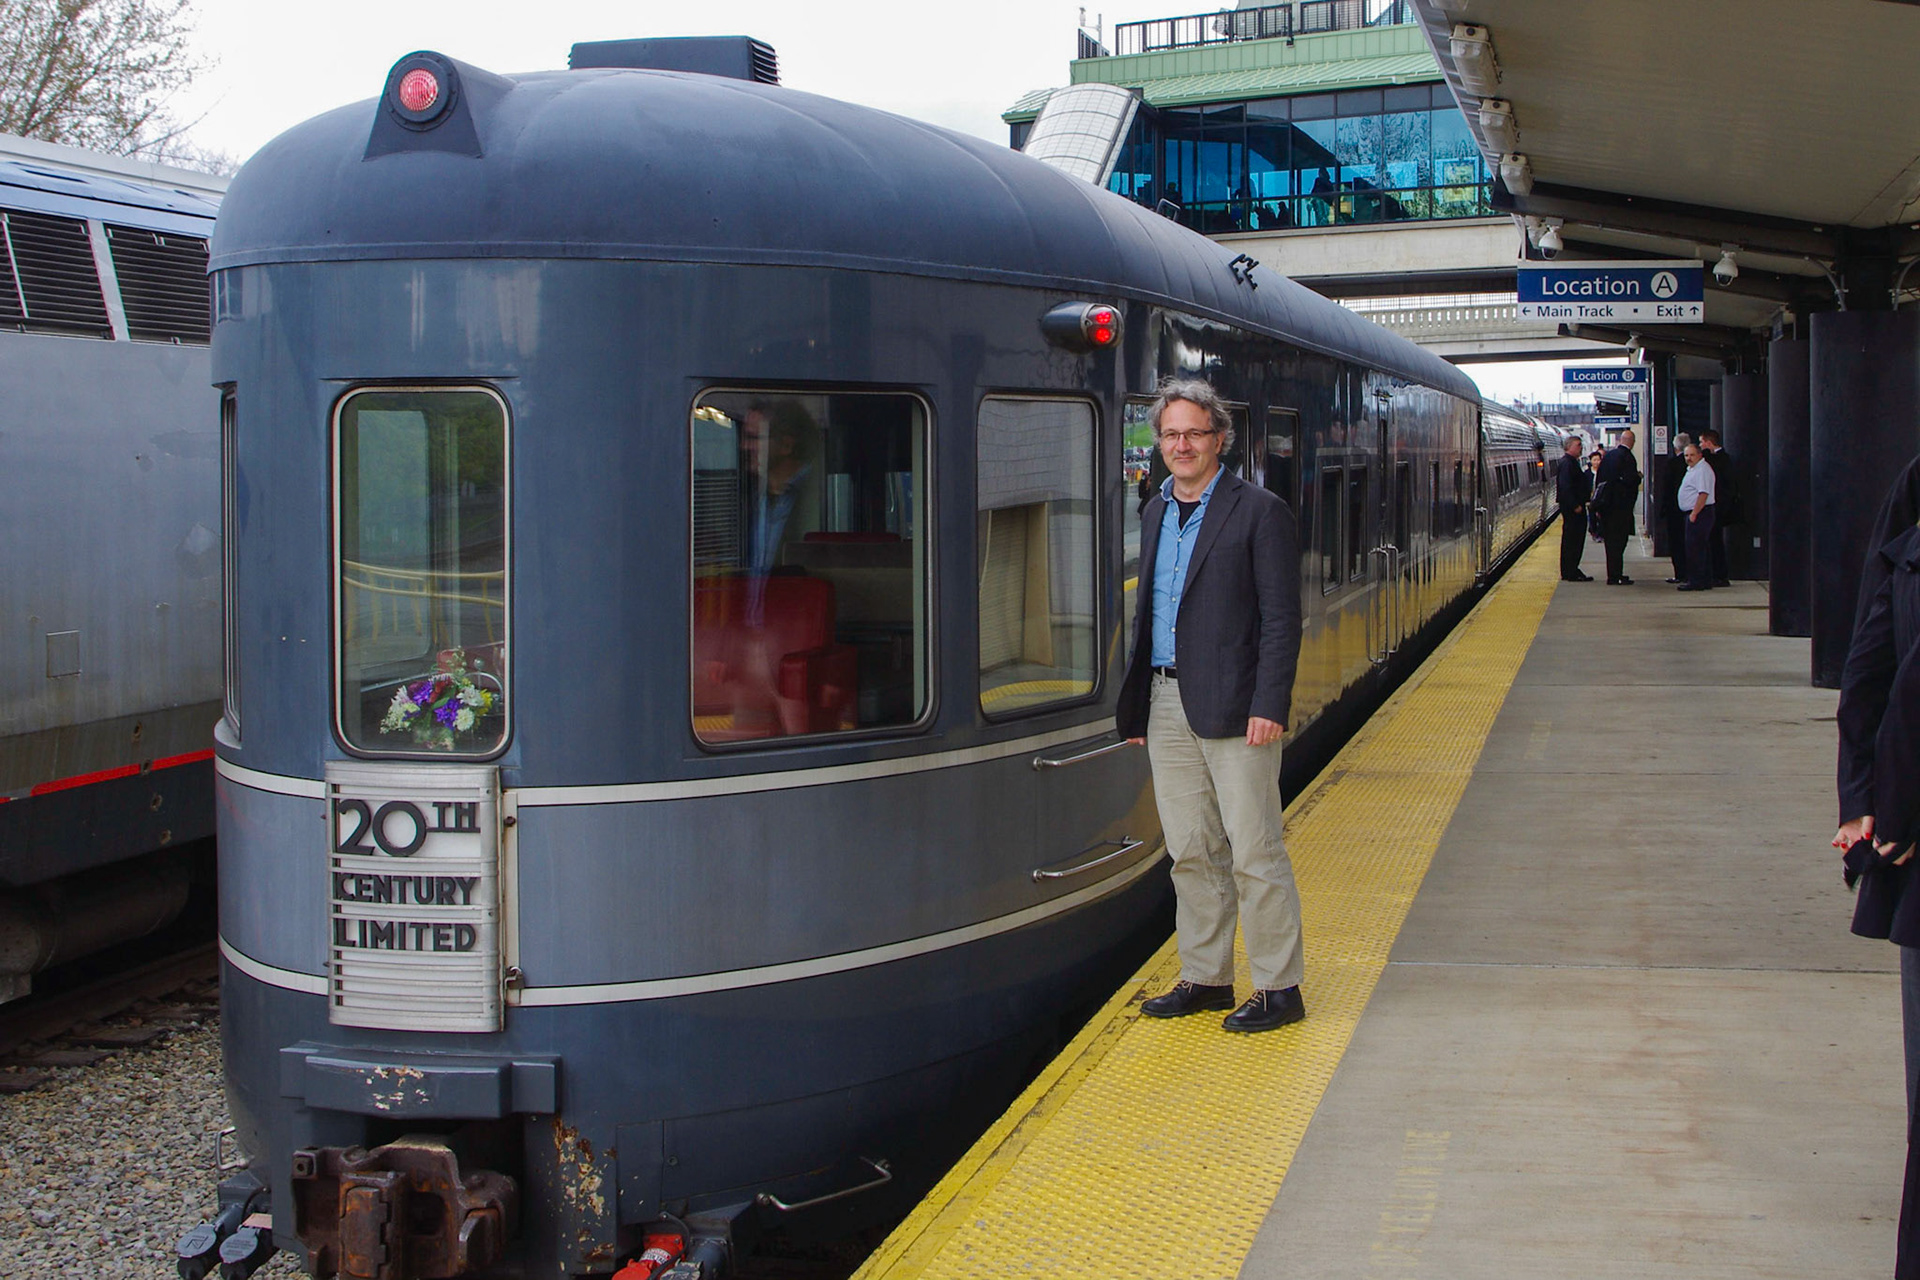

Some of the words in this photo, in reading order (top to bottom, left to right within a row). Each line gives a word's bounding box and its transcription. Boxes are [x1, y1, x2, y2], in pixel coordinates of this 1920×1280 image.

[1541, 275, 1640, 296] Location
[1654, 274, 1674, 294] A
[1537, 305, 1573, 318] Main
[1577, 305, 1614, 318] Track
[1656, 305, 1684, 318] Exit
[1572, 371, 1618, 381] Location
[1611, 383, 1638, 391] Elevator
[337, 799, 481, 858] 20TH
[336, 872, 481, 906] CENTURY
[336, 918, 477, 952] LIMITED
